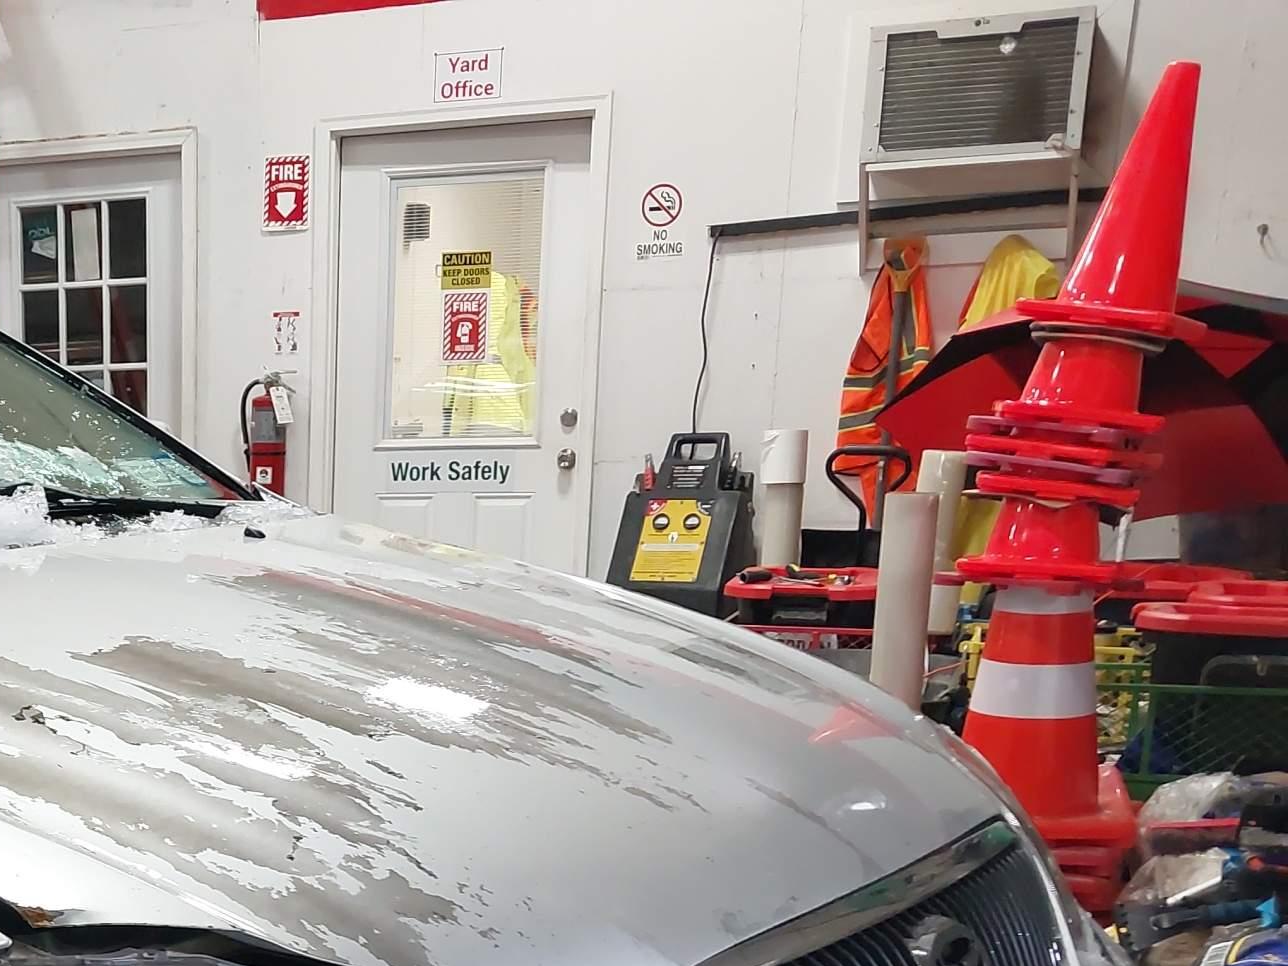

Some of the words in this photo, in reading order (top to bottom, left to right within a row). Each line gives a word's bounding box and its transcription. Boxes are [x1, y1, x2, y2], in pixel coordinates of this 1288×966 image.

[448, 53, 489, 73] Yard
[441, 80, 494, 99] Office
[271, 163, 303, 181] FIRE
[653, 229, 668, 241] NO
[636, 242, 683, 256] SMOKING
[444, 253, 490, 266] CAUTION
[443, 269, 462, 277] KEEP
[463, 267, 490, 276] DOORS
[451, 277, 481, 286] CLOSED
[452, 301, 479, 312] FIRE
[391, 461, 441, 481] Work
[448, 460, 510, 484] Safely
